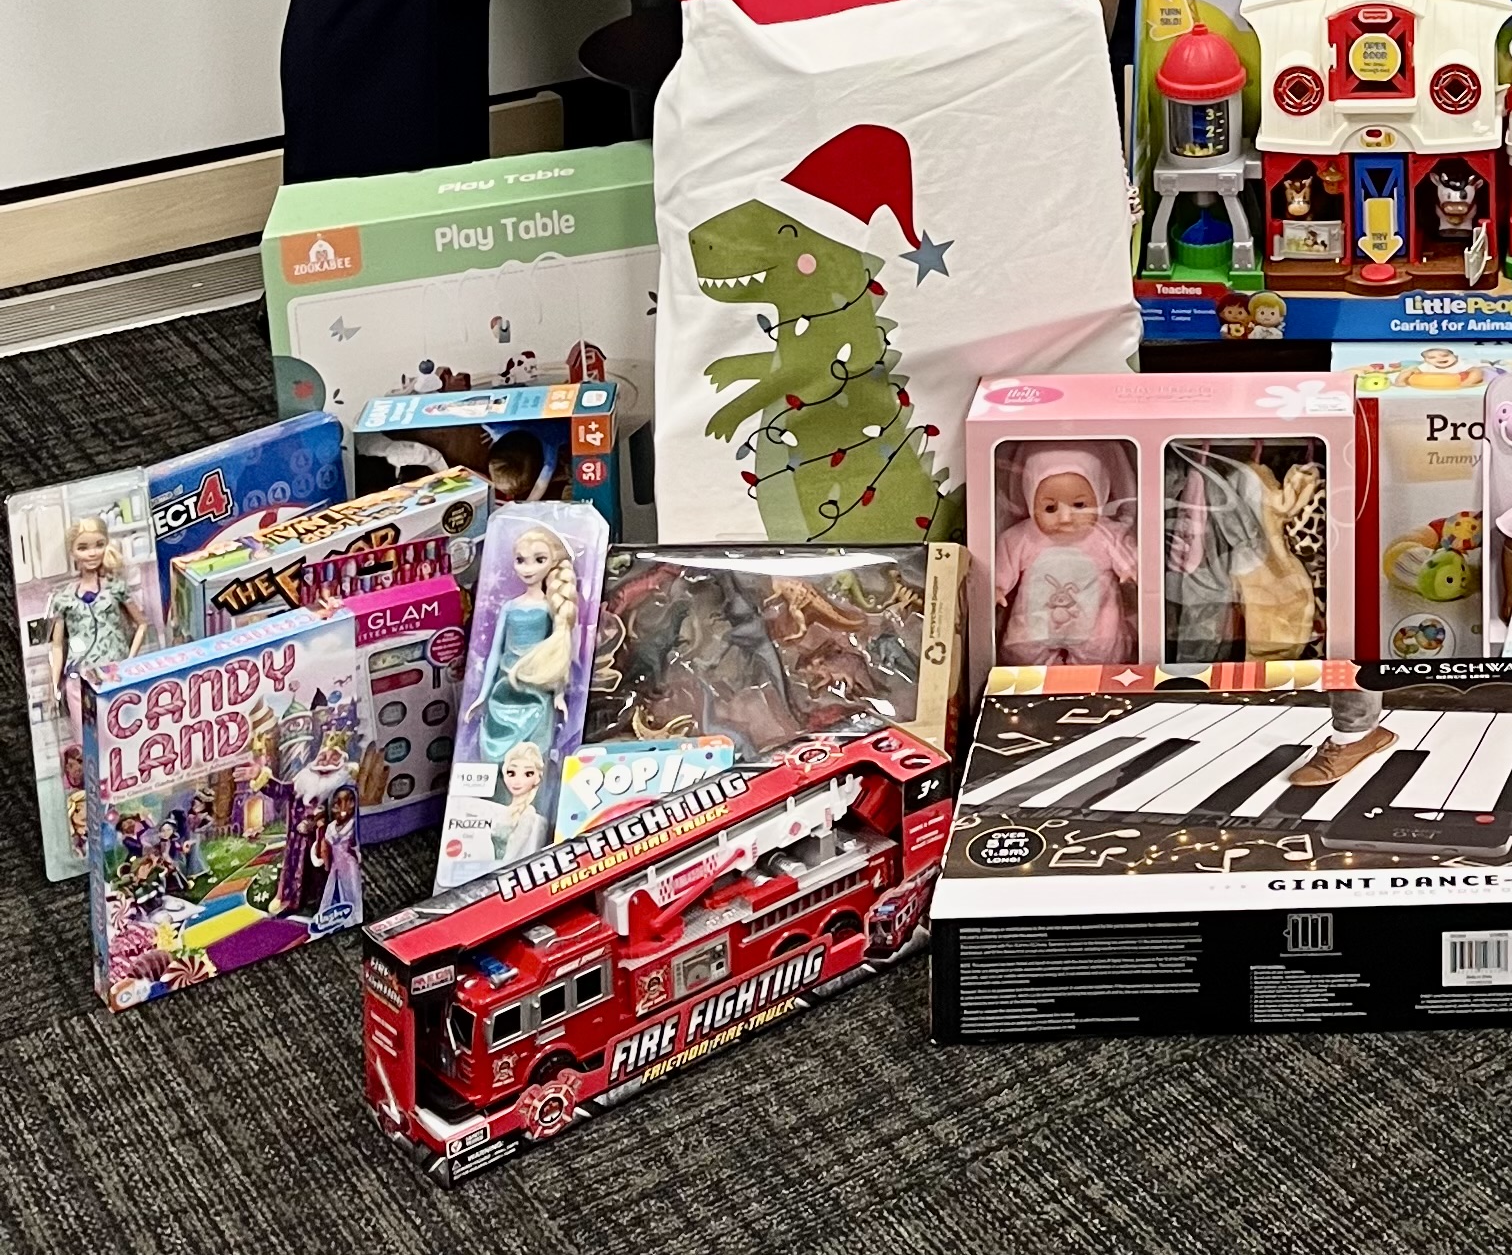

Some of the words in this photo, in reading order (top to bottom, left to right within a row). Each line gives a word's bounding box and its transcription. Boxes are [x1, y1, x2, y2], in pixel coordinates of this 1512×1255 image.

[1206, 126, 1215, 138] 2
[437, 177, 496, 196] Play
[502, 165, 576, 186] Table
[433, 222, 496, 254] Play
[500, 208, 576, 244] Table
[292, 255, 352, 277] ZOOKABEE
[1390, 319, 1439, 336] Caring
[1440, 319, 1465, 332] for
[217, 573, 275, 613] THE
[367, 600, 440, 631] GLAM
[106, 642, 297, 741] CANDY
[108, 710, 251, 793] LAND
[575, 756, 660, 811] POP
[448, 817, 492, 830] FROZEN
[497, 841, 580, 901] FIRE
[585, 771, 749, 860] FIGHTING
[550, 848, 631, 895] FRICTION
[632, 830, 670, 851] FIRE
[672, 804, 730, 837] TRUCK
[1267, 876, 1377, 892] GIANT
[609, 1014, 680, 1082] FIRE
[686, 945, 826, 1044] FIGHTING
[641, 1037, 712, 1086] FRICTION
